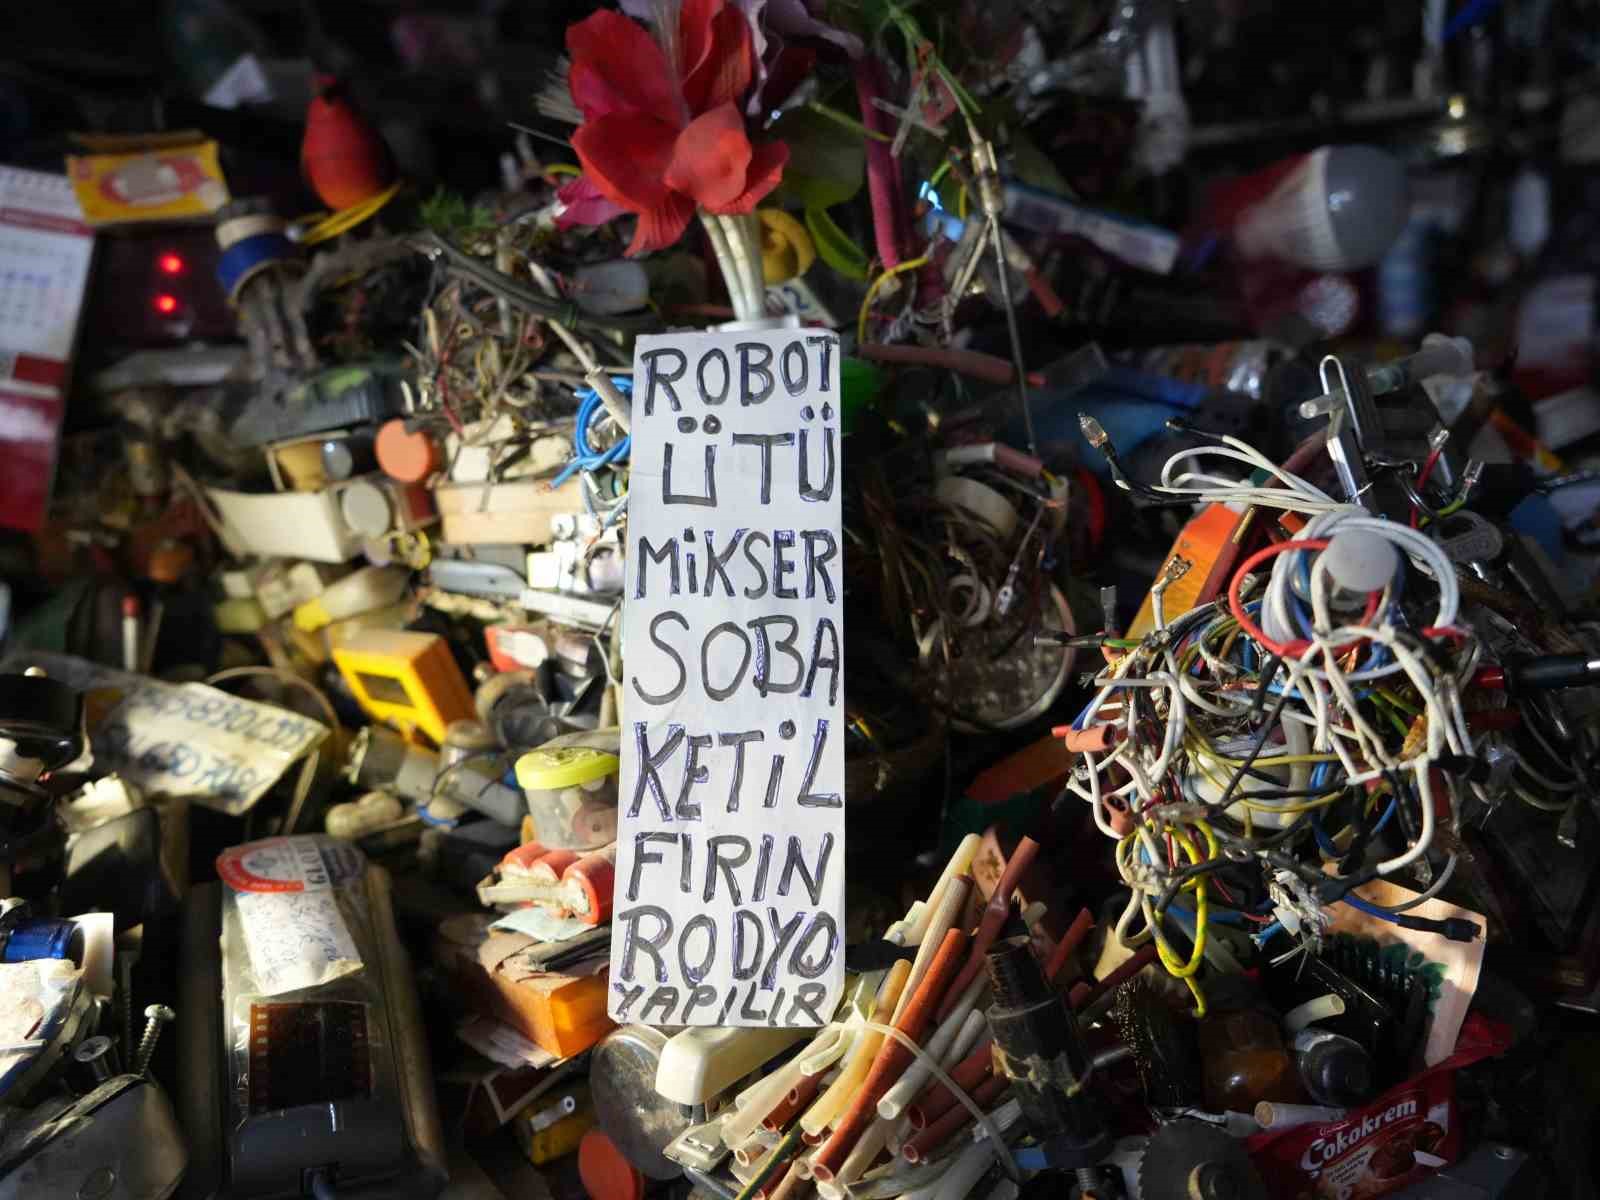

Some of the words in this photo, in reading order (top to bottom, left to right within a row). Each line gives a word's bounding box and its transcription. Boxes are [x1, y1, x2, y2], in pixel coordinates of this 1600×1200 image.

[640, 336, 840, 416] ROBOT
[663, 402, 835, 507] ÜTÜ
[632, 611, 840, 706] SOBA
[626, 832, 835, 906] FIRIN
[619, 904, 839, 991] RODYO
[614, 981, 826, 1026] YAPILIR
